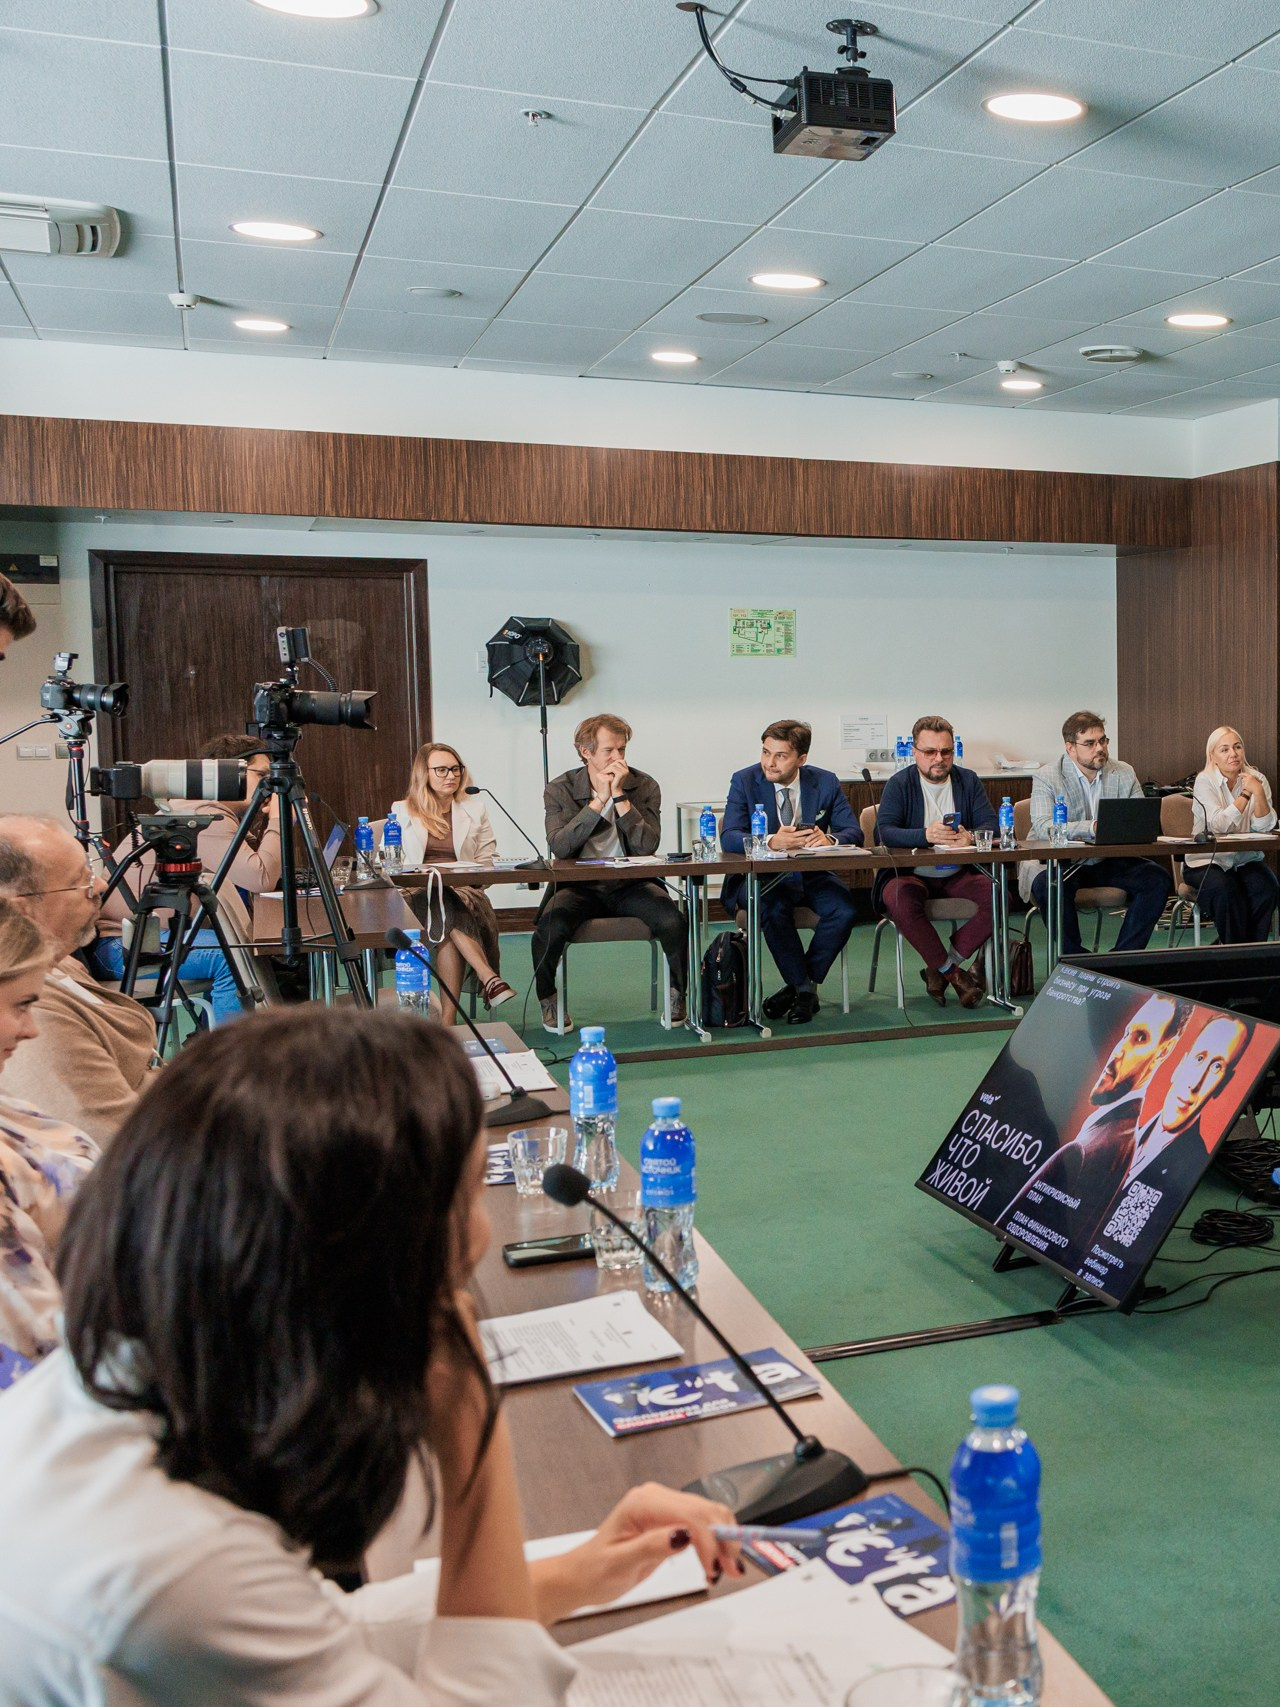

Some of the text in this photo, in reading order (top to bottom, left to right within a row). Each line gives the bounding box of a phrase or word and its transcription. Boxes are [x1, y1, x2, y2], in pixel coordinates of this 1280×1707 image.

[948, 1133, 981, 1169] ЧТО
[961, 1109, 1043, 1173] СПАСИБО,
[925, 1158, 993, 1211] ЖИВОЙ
[1026, 1189, 1044, 1205] ПЛАН
[1033, 1180, 1081, 1210] АНТИКРИЗИСНЫЙ
[1006, 1221, 1049, 1252] ОЗДОРОВЛЕНИЯ
[1012, 1210, 1069, 1249] ПЛАН ФИНАНСОВОГО
[1083, 1257, 1109, 1276] вебинар
[1091, 1243, 1125, 1269] Посмотреть
[1082, 1272, 1105, 1289] записи
